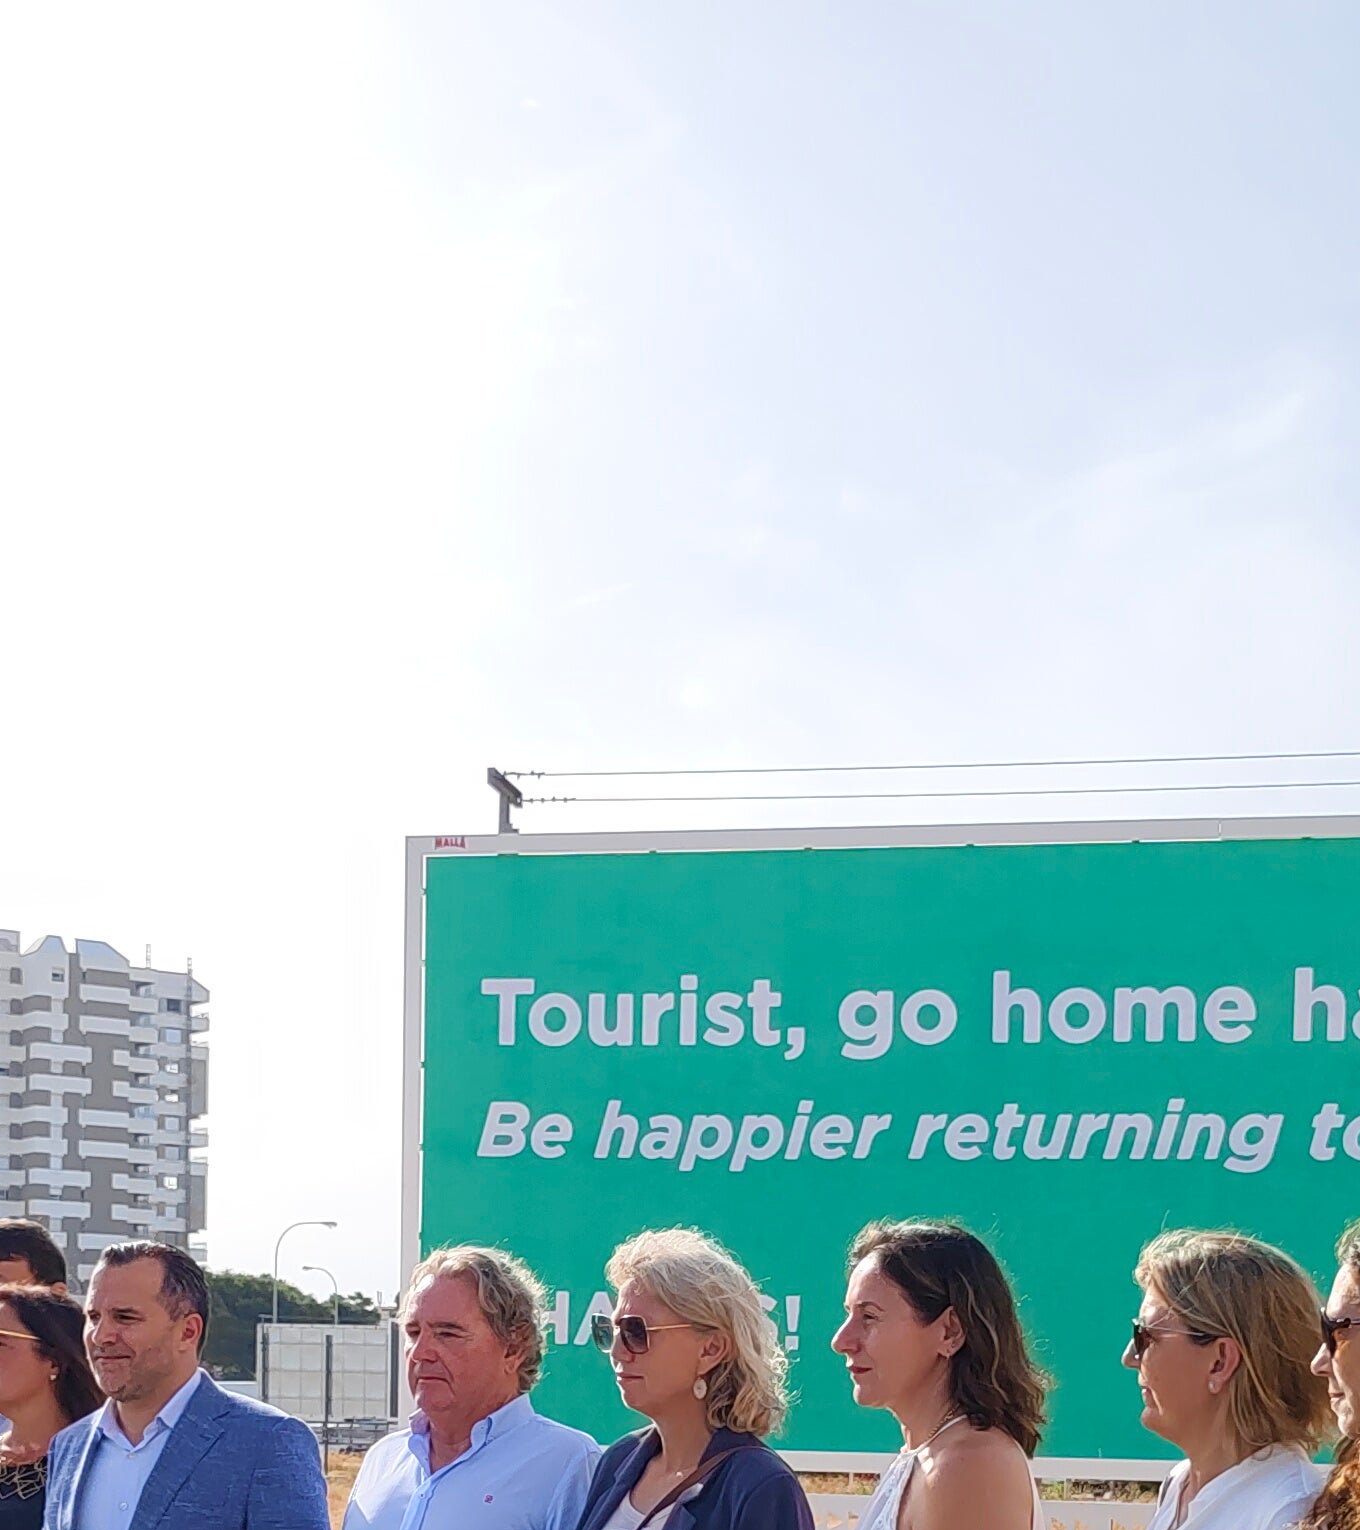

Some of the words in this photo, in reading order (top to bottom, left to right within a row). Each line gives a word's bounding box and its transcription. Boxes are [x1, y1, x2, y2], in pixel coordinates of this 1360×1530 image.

[481, 974, 807, 1060] Tourist,
[838, 990, 958, 1060] go
[992, 970, 1257, 1045] home
[477, 1100, 573, 1159] Be
[594, 1099, 892, 1172] happier
[909, 1097, 1283, 1173] returning
